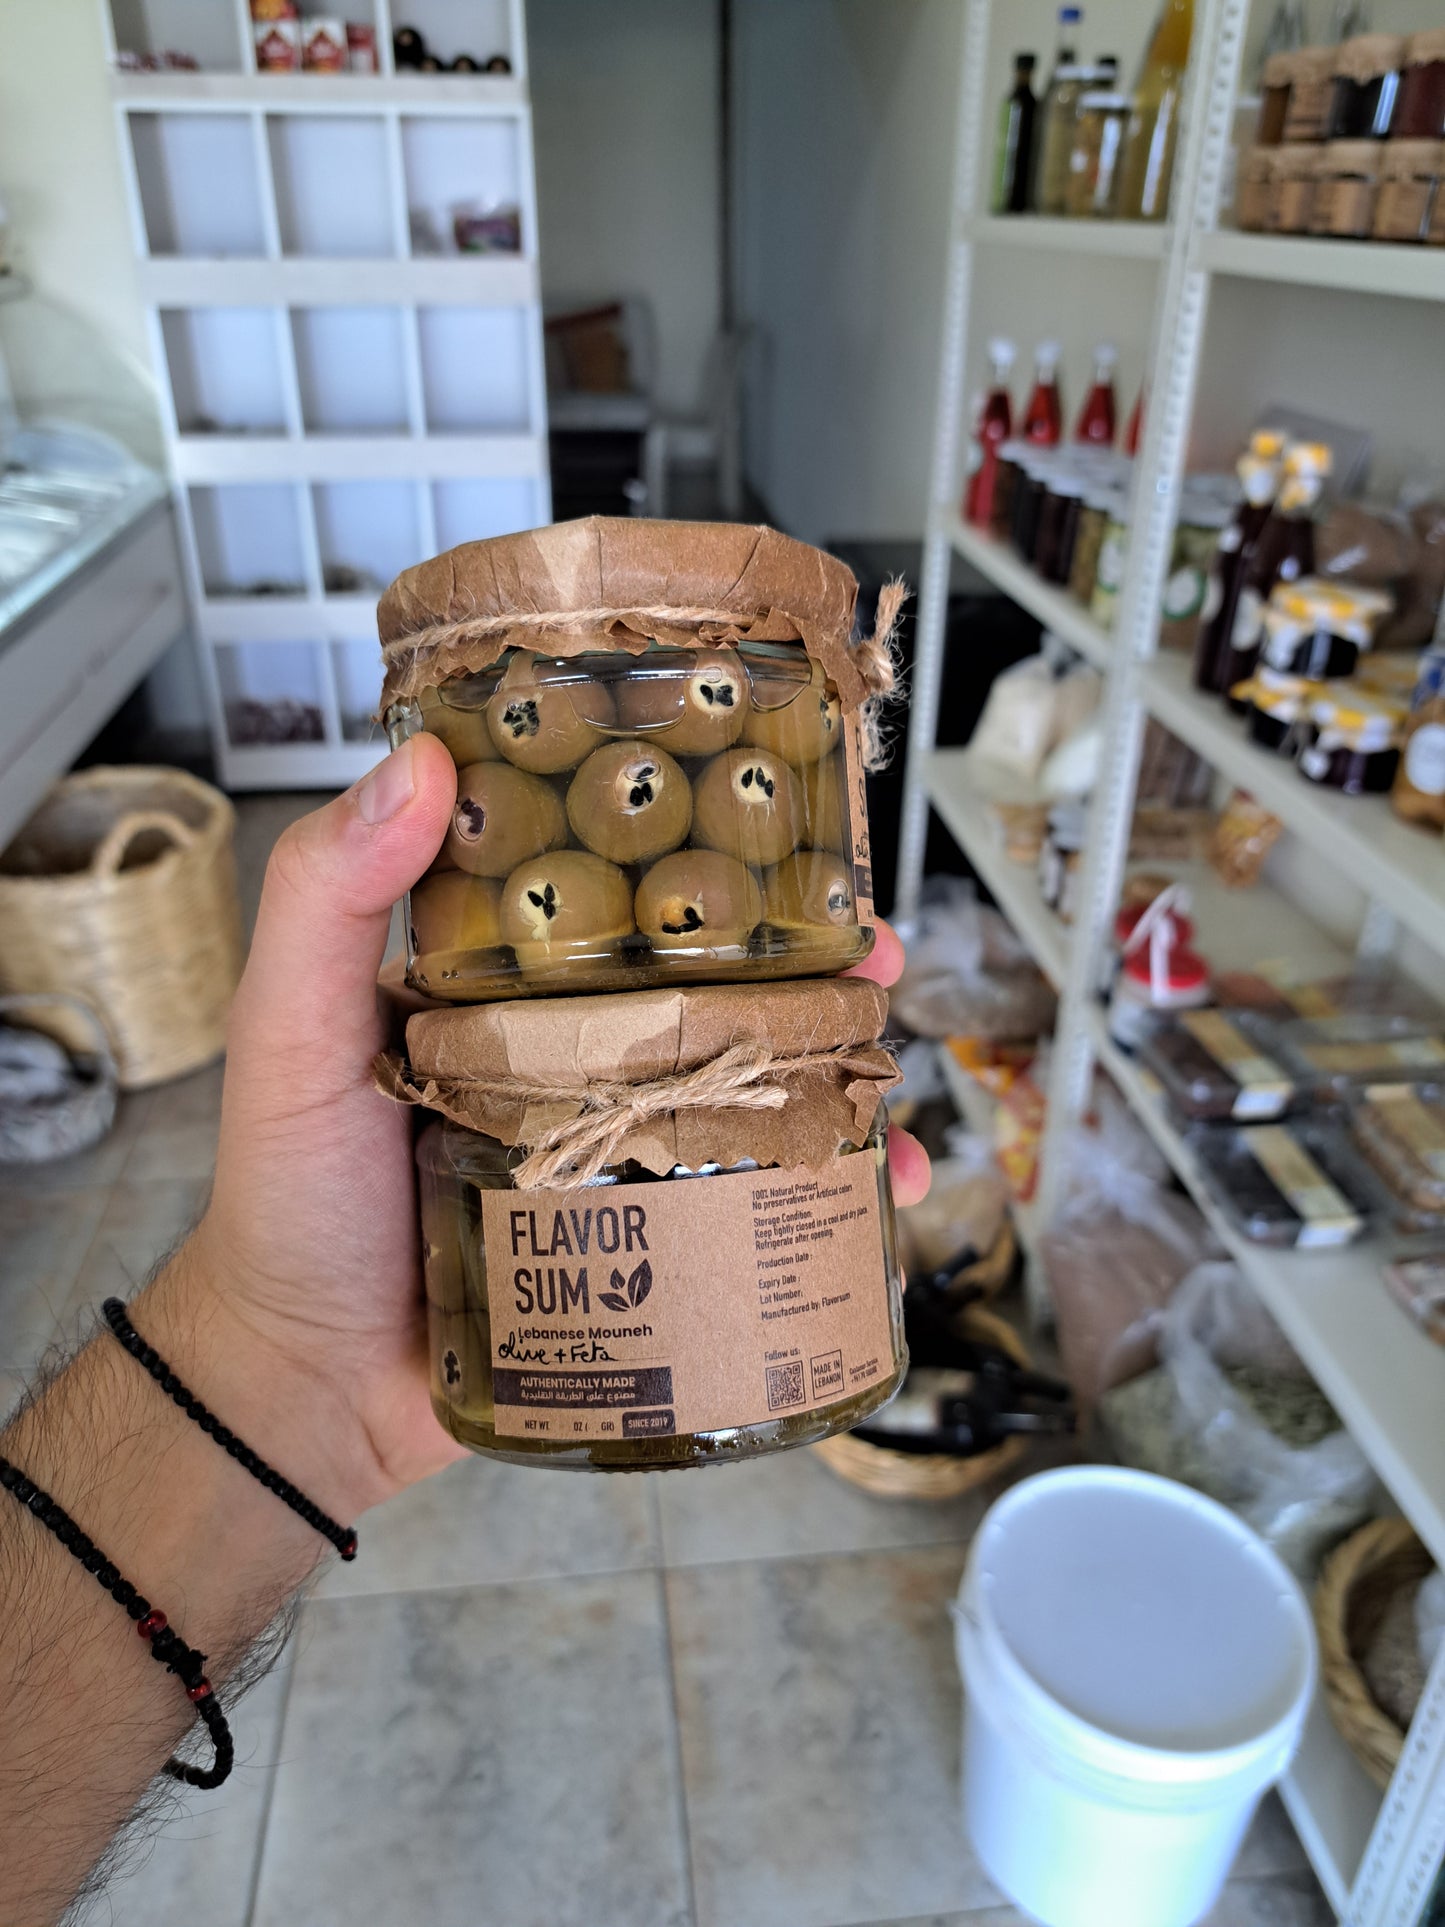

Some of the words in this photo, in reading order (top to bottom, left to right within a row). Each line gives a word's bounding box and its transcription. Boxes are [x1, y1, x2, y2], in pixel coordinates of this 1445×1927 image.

[770, 1185, 794, 1198] Natural
[795, 1181, 818, 1193] Product
[752, 1201, 763, 1211] No
[764, 1194, 808, 1211] preservatives
[808, 1192, 815, 1201] or
[816, 1187, 838, 1199] Artificial
[753, 1215, 781, 1229] Storage
[754, 1228, 773, 1240] Keep
[774, 1222, 794, 1237] tightly
[795, 1219, 816, 1232] closed
[816, 1218, 823, 1227] in
[828, 1214, 839, 1225] cool
[509, 1204, 650, 1257] FLAVOR
[755, 1235, 794, 1251] Refrigerate
[795, 1233, 809, 1244] after
[757, 1255, 794, 1270] Production
[513, 1266, 591, 1315] SUM
[758, 1277, 781, 1290] Expiry
[759, 1294, 772, 1305] Lot
[761, 1301, 810, 1321] Manufactured
[821, 1292, 851, 1307] Flavorsum
[518, 1326, 585, 1340] Lebanese
[588, 1324, 653, 1339] Mouneh
[764, 1349, 788, 1362] Follow
[813, 1363, 832, 1375] MADE
[833, 1359, 841, 1370] IN
[520, 1376, 600, 1388] AUTHENTICALLY
[602, 1376, 636, 1388] MADE
[814, 1372, 842, 1389] LEBANON
[555, 1390, 584, 1402] الطريقة
[606, 1391, 636, 1403] مصنوع
[524, 1419, 537, 1430] NET
[573, 1421, 583, 1432] OZ
[627, 1418, 649, 1428] SINCE
[650, 1417, 668, 1428] 2019
